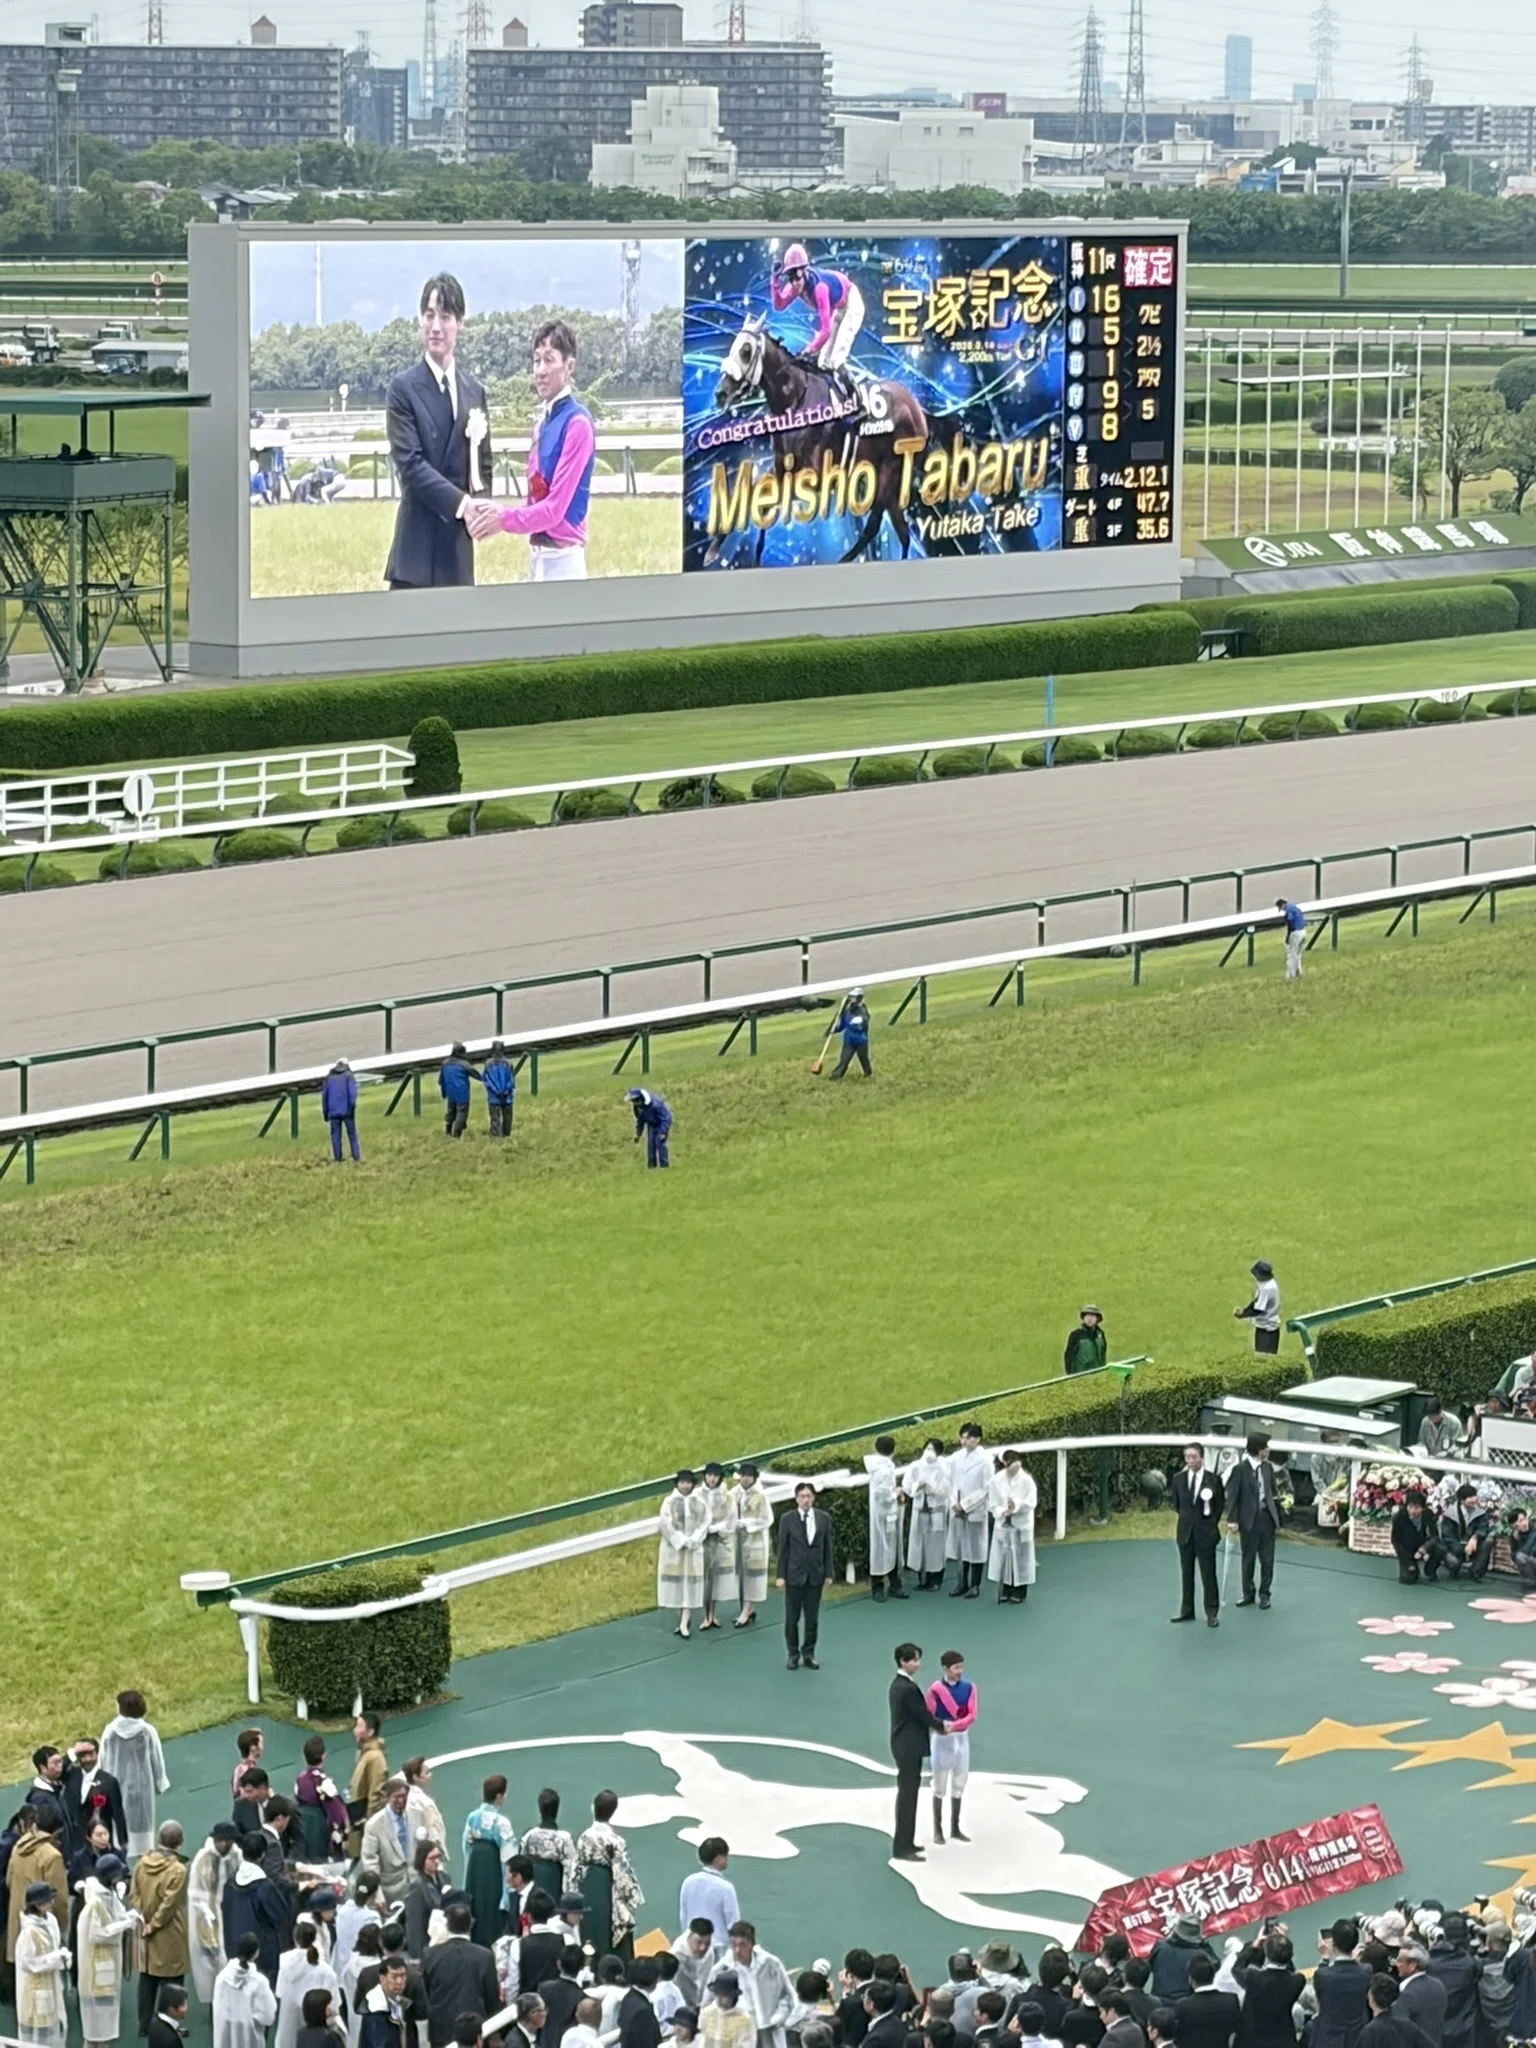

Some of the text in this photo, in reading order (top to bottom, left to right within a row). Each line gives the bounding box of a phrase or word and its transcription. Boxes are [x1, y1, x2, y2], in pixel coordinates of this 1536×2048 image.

[1124, 248, 1173, 286] 確定
[881, 259, 1058, 344] 宝塚記念
[1092, 284, 1120, 313] 16
[1139, 304, 1161, 325] クビ
[1103, 316, 1120, 345] 5
[1106, 348, 1115, 377] 1
[1103, 380, 1119, 409] 9
[1141, 398, 1155, 420] 5
[698, 391, 858, 450] Congratulations!
[1102, 412, 1119, 441] 8
[707, 433, 1049, 537] Meisho Tabaru
[1124, 465, 1169, 489] 2.12.1
[1065, 497, 1097, 518] ダート
[1136, 491, 1170, 513] 47.7
[916, 503, 1040, 541] Yutaka Take
[1136, 517, 1169, 540] 35.6
[1283, 541, 1324, 558] JRA
[1149, 1864, 1262, 1937] 宝塚記念
[1263, 1854, 1304, 1890] 6.14
